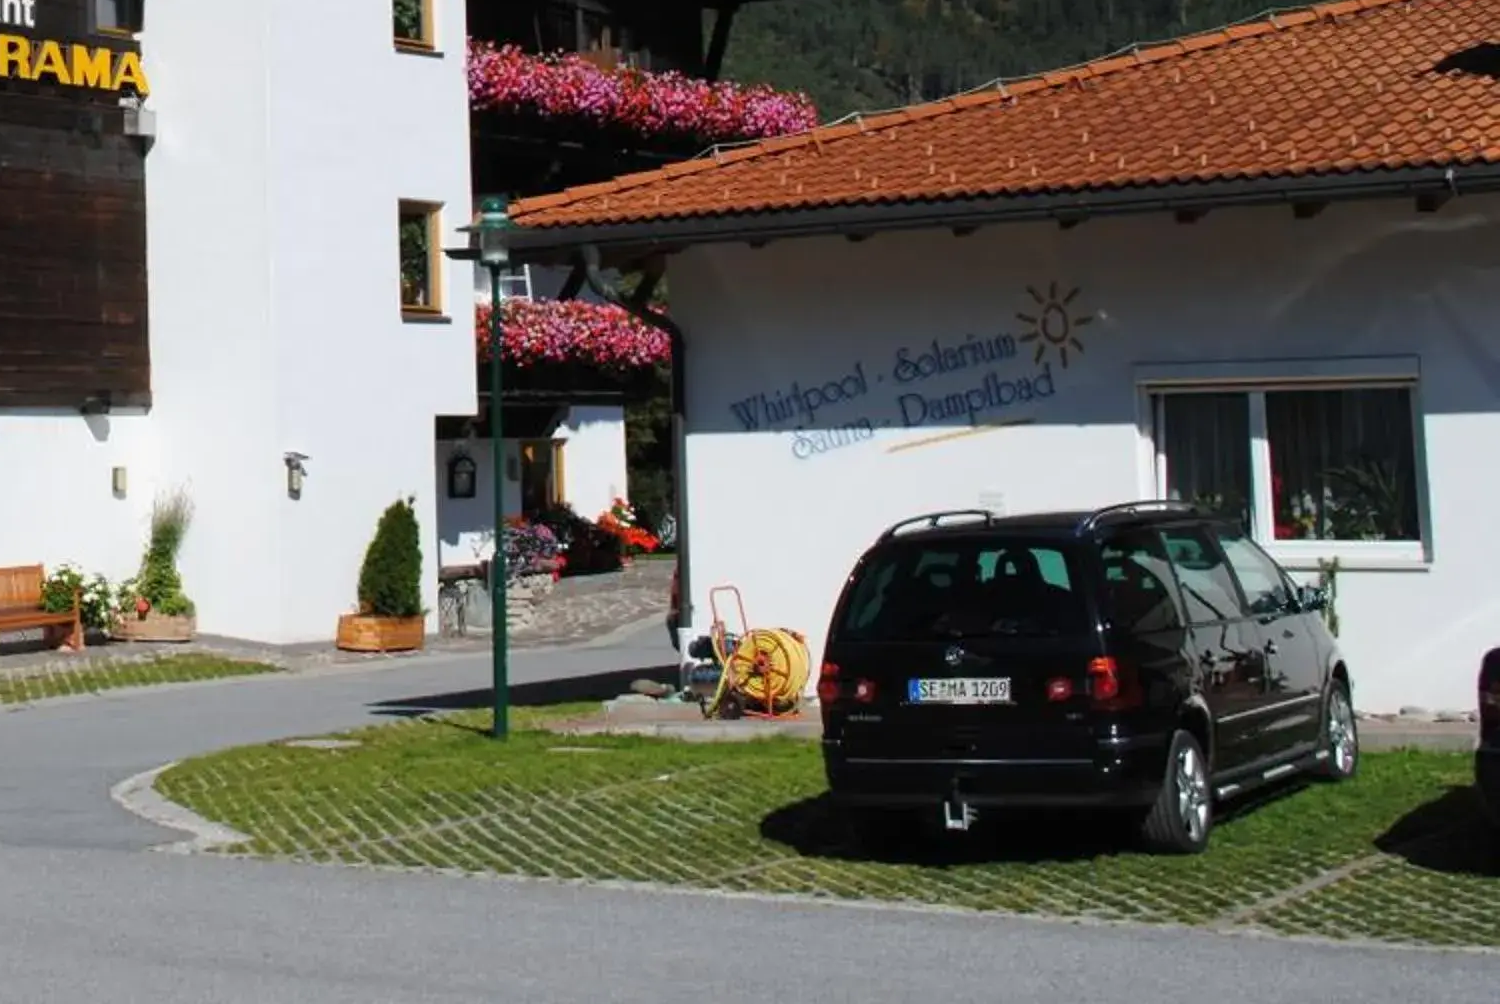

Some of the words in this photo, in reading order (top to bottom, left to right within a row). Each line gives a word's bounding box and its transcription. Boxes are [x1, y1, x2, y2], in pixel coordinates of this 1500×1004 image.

[729, 361, 869, 431] Whirlpool
[893, 332, 1018, 383] Solarium
[791, 424, 876, 460] Sauna
[897, 362, 1057, 427] Dampfbad
[971, 680, 1007, 698] 1209
